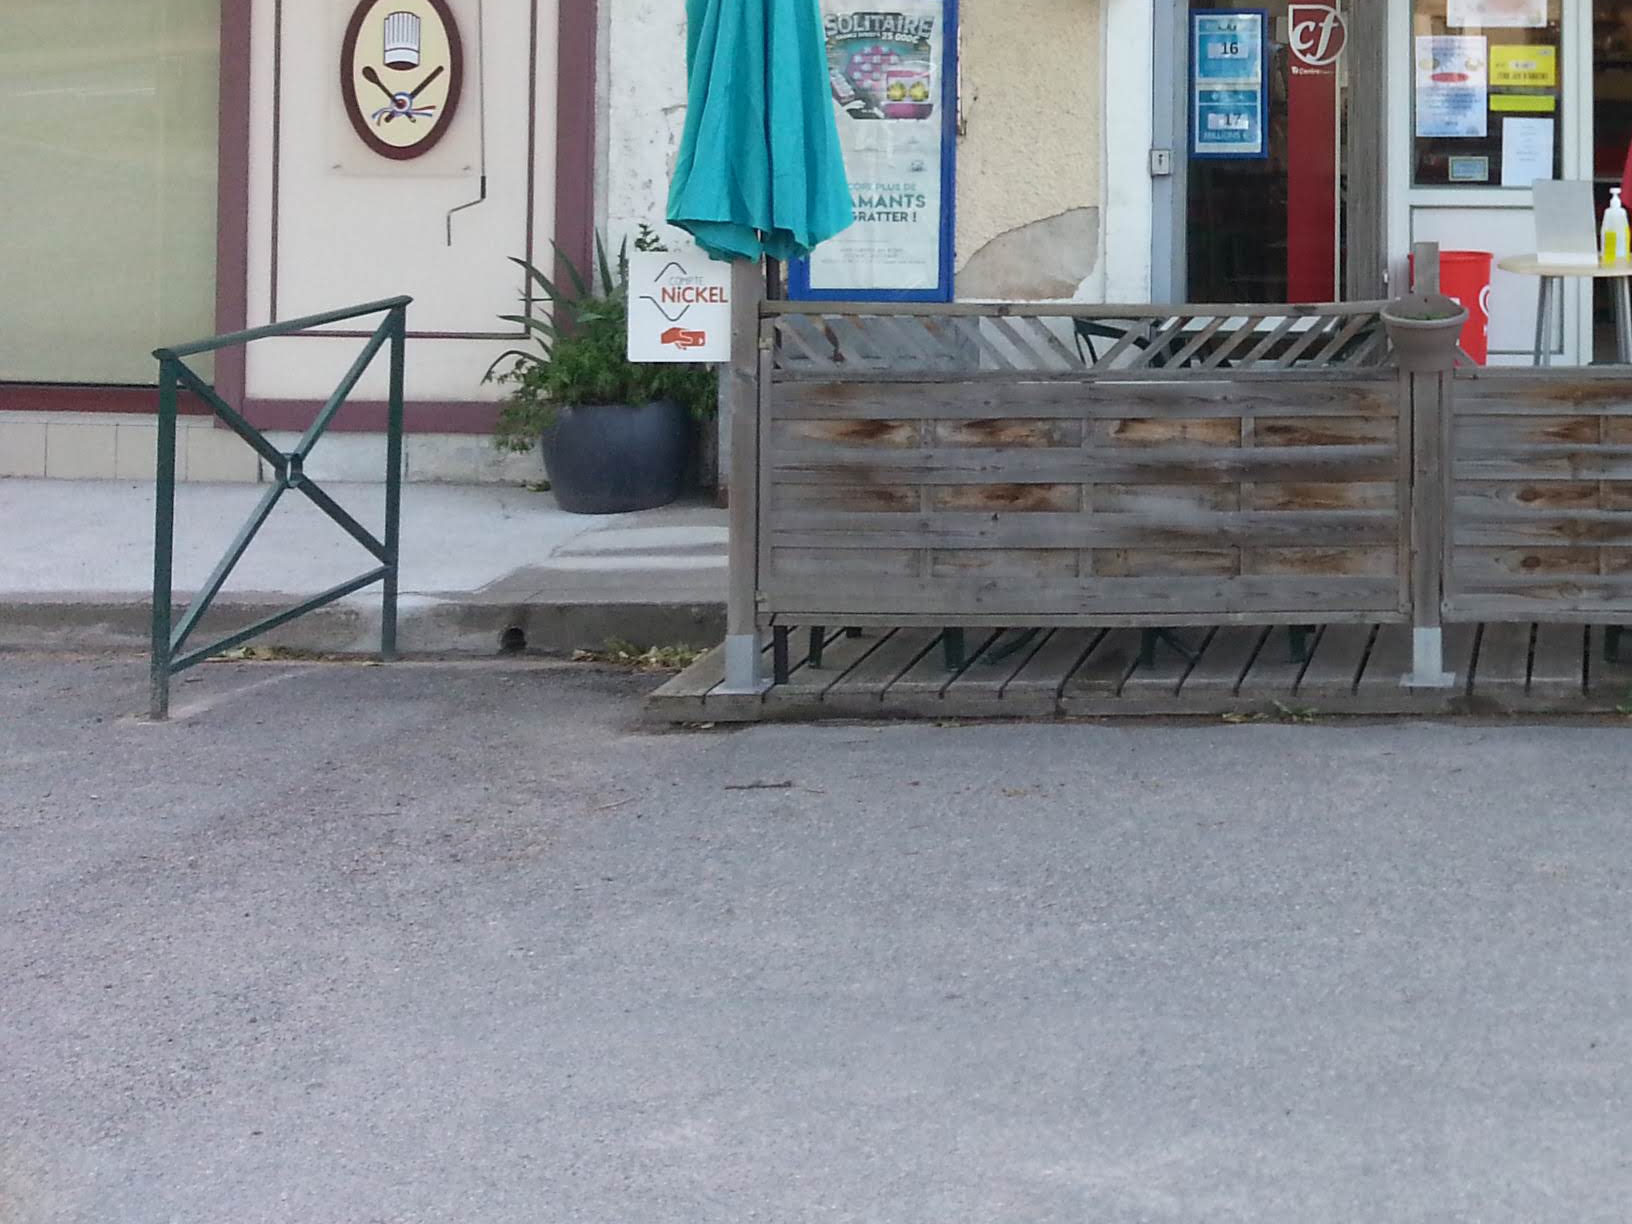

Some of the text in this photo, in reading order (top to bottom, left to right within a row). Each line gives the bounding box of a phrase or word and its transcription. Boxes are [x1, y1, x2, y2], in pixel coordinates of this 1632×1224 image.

[824, 14, 935, 40] SOLITAIRE
[1221, 41, 1240, 56] 16
[852, 194, 926, 209] MANTS
